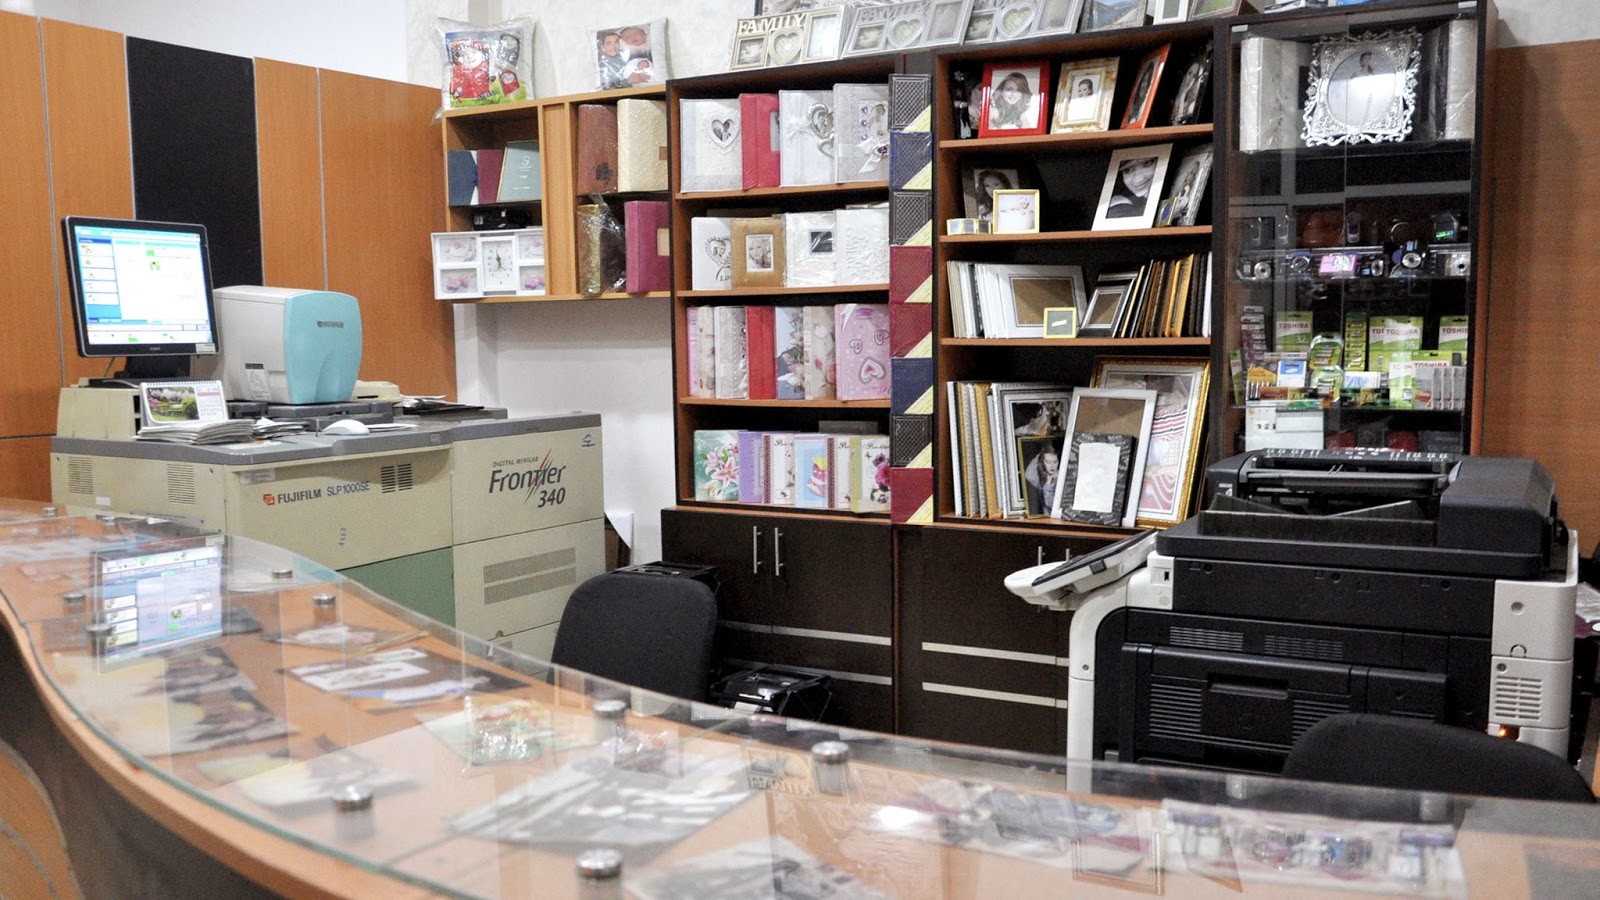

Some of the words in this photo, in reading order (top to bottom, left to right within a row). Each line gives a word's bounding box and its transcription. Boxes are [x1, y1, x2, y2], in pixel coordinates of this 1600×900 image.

[738, 13, 807, 35] FAMILY
[493, 460, 514, 468] DIGITAL
[489, 465, 567, 493] Frontier
[277, 489, 322, 504] FUJIFILM
[538, 487, 566, 508] 340
